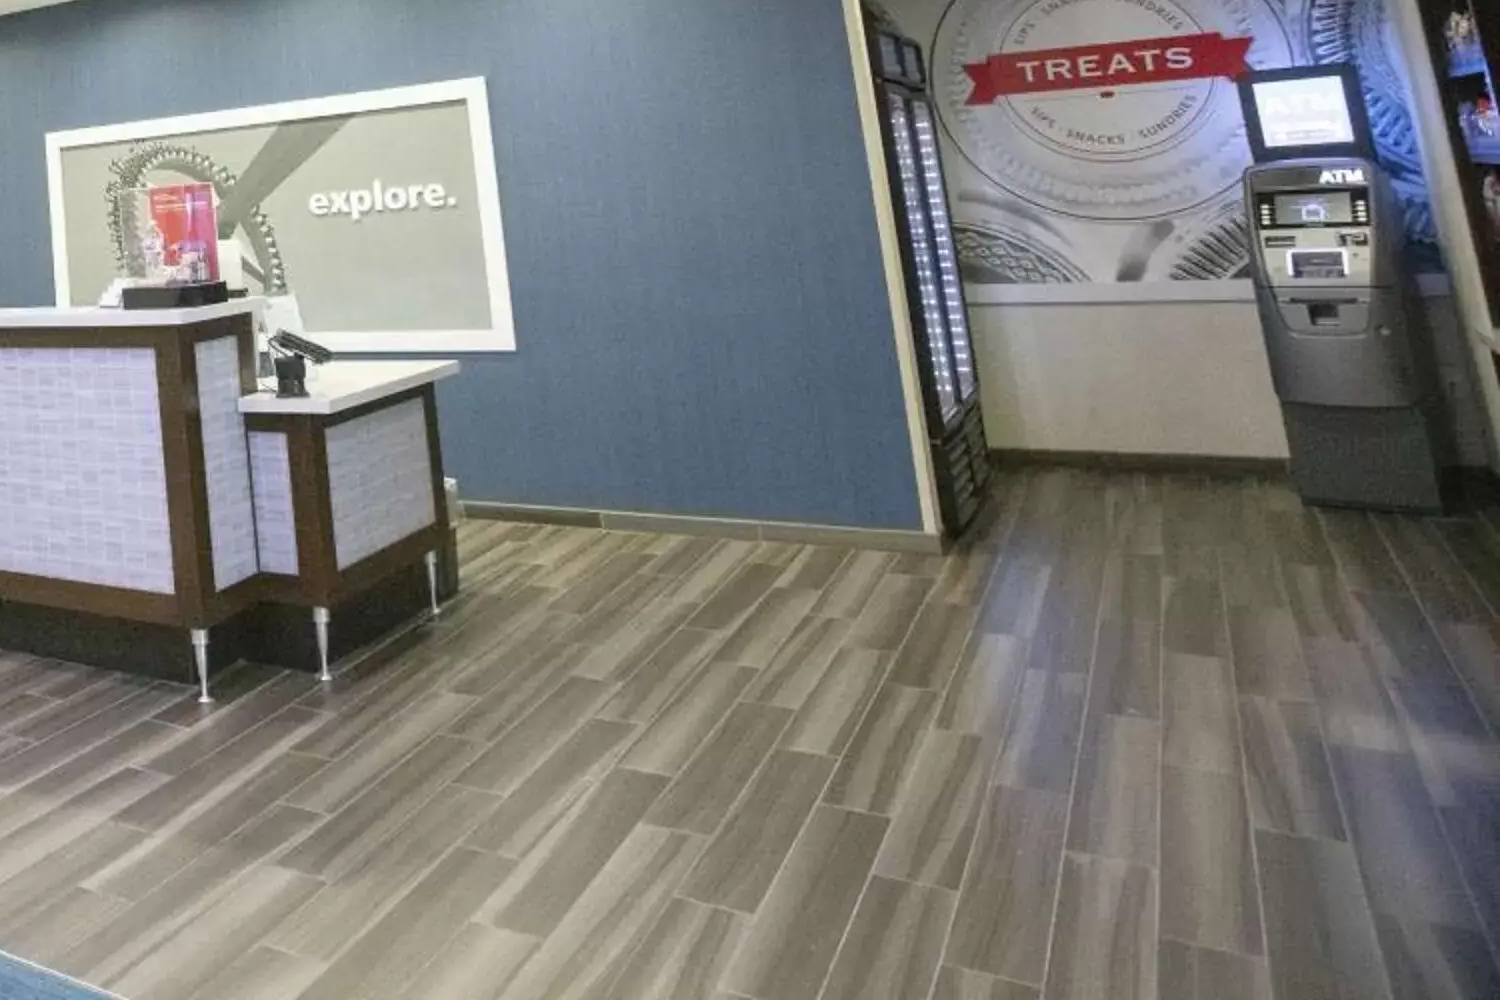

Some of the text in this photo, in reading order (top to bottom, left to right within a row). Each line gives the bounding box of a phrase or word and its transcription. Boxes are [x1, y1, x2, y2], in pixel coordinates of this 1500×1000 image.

[1016, 46, 1194, 83] TREATS
[1066, 128, 1125, 145] SNACKS
[1137, 94, 1198, 139] SUNDRIES
[1319, 168, 1366, 184] ATM
[307, 178, 457, 221] explore.
